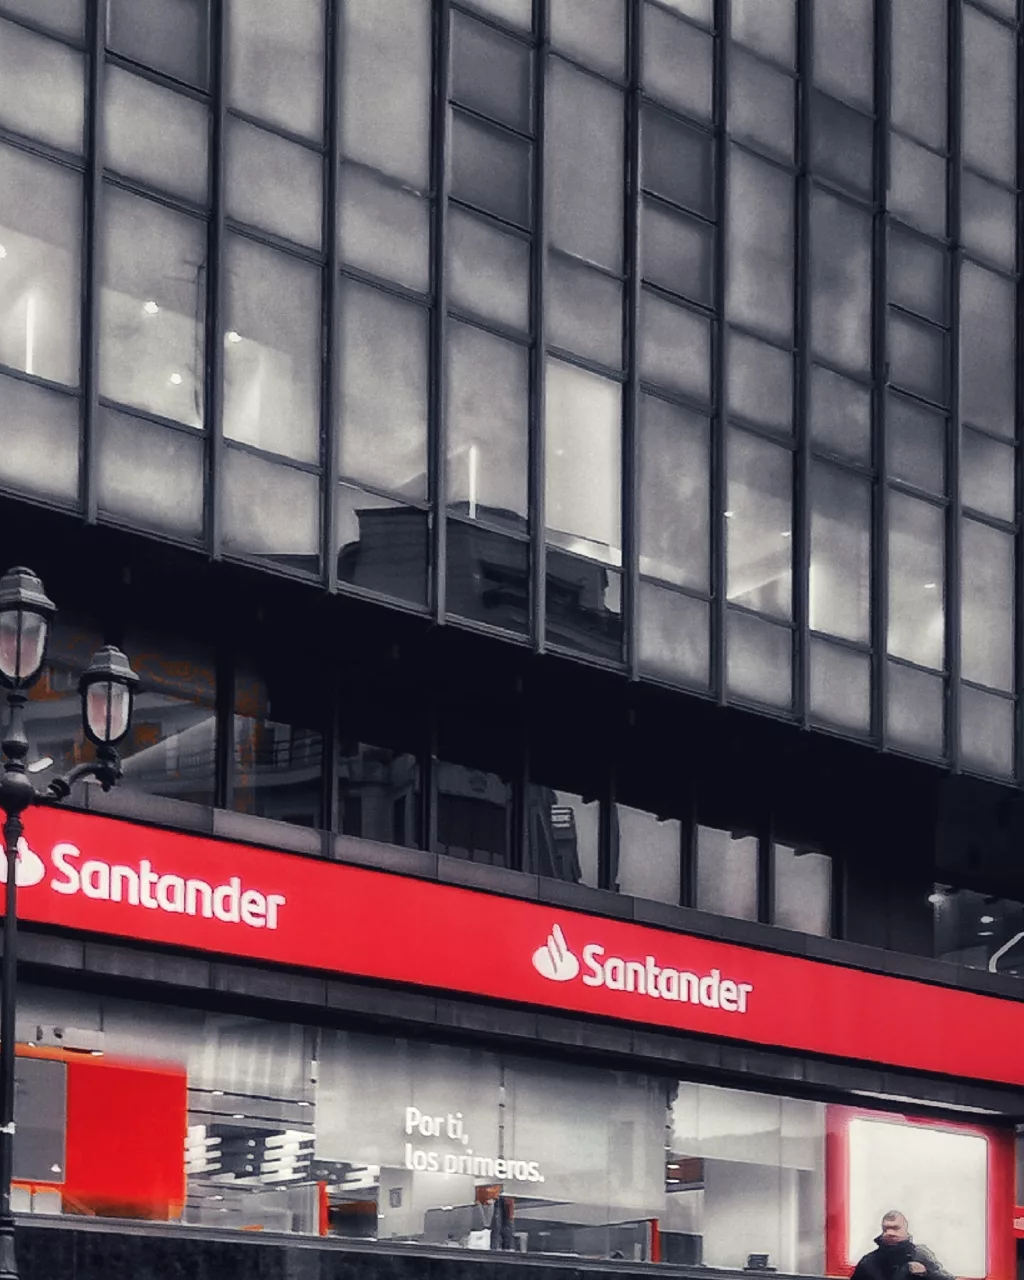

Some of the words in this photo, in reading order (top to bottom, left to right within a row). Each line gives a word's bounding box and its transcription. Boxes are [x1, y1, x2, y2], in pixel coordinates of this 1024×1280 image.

[50, 842, 286, 930] Santander
[581, 944, 753, 1014] Santander
[405, 1106, 444, 1136] Por
[447, 1112, 469, 1145] ti,
[404, 1142, 438, 1172] los
[443, 1149, 545, 1183] primeros.
